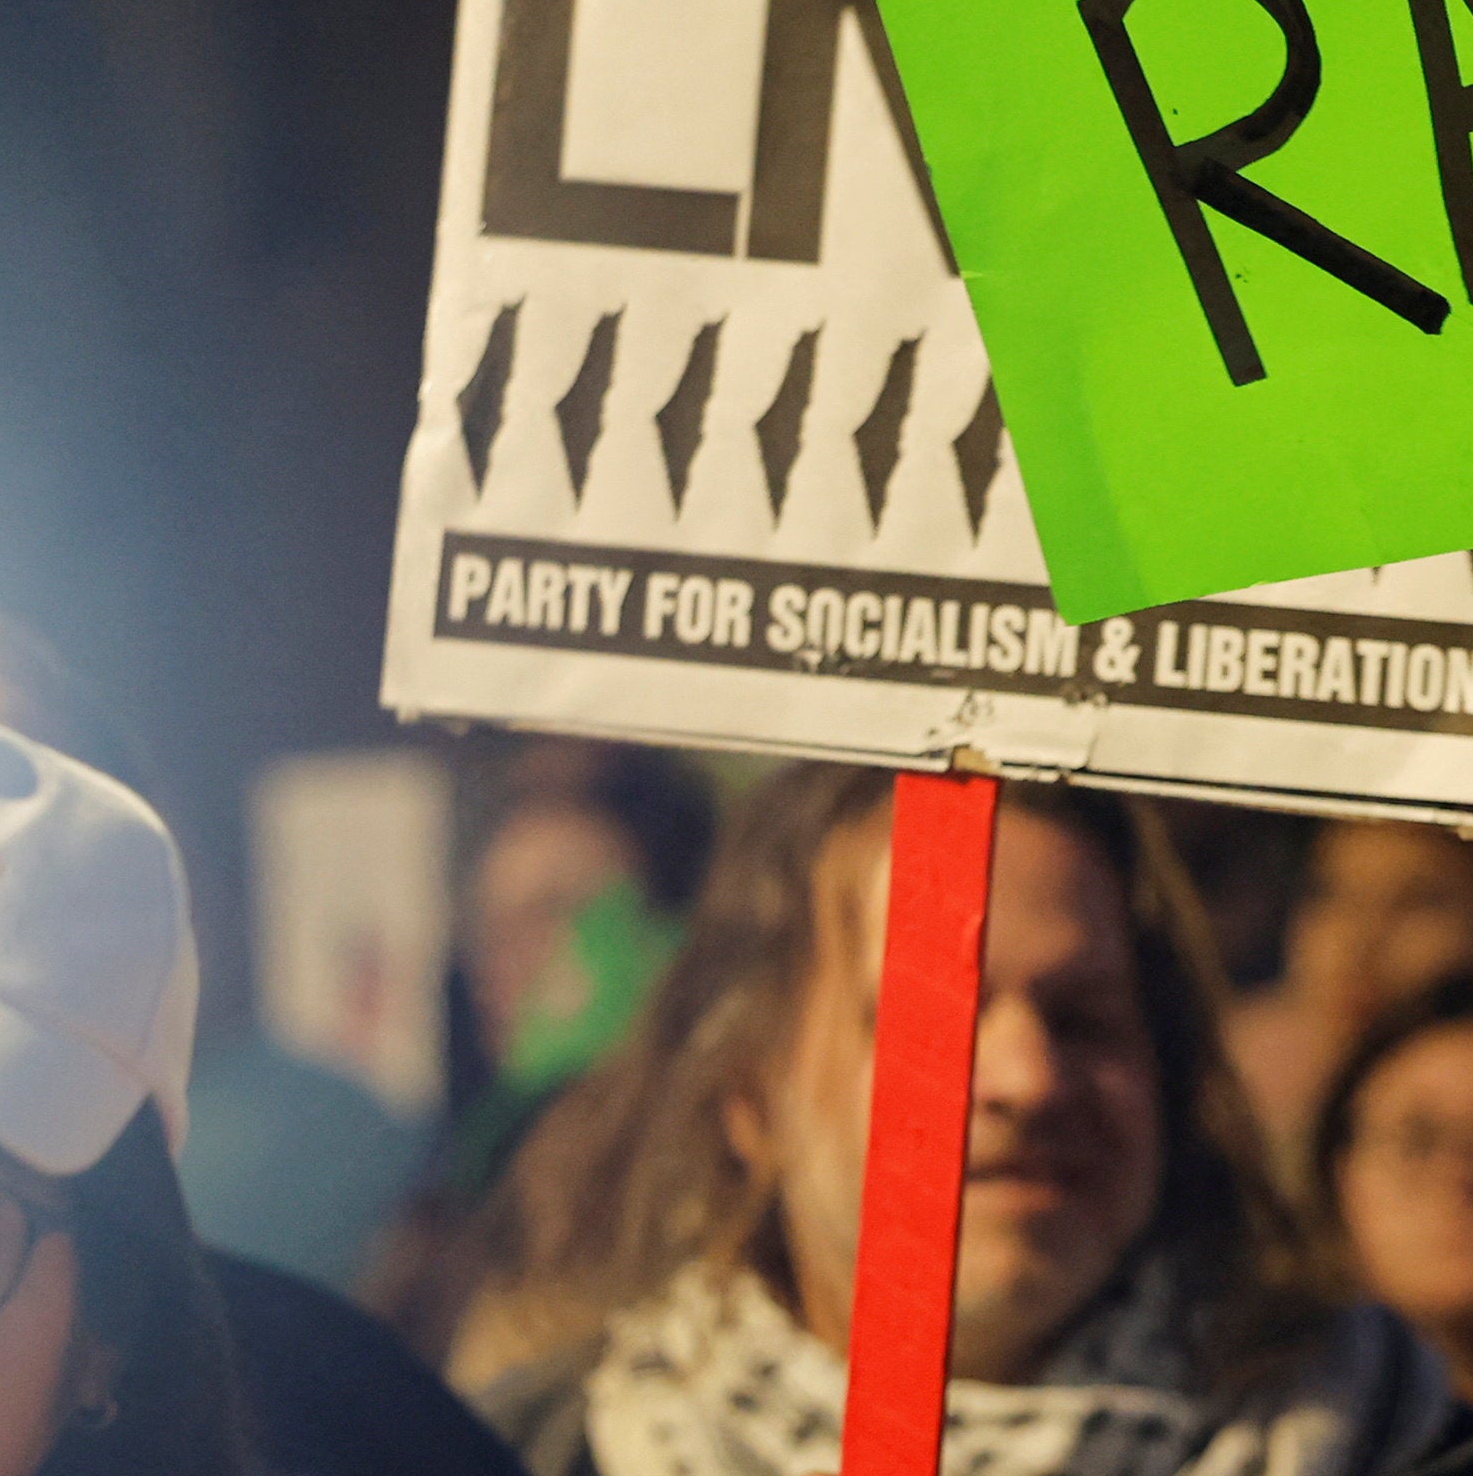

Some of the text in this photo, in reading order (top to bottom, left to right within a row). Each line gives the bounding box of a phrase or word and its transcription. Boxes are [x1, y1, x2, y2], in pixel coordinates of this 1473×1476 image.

[447, 552, 633, 637] PARTY
[642, 572, 755, 649] FOR
[767, 583, 1080, 679] SOCIALISM
[1093, 618, 1141, 685] &
